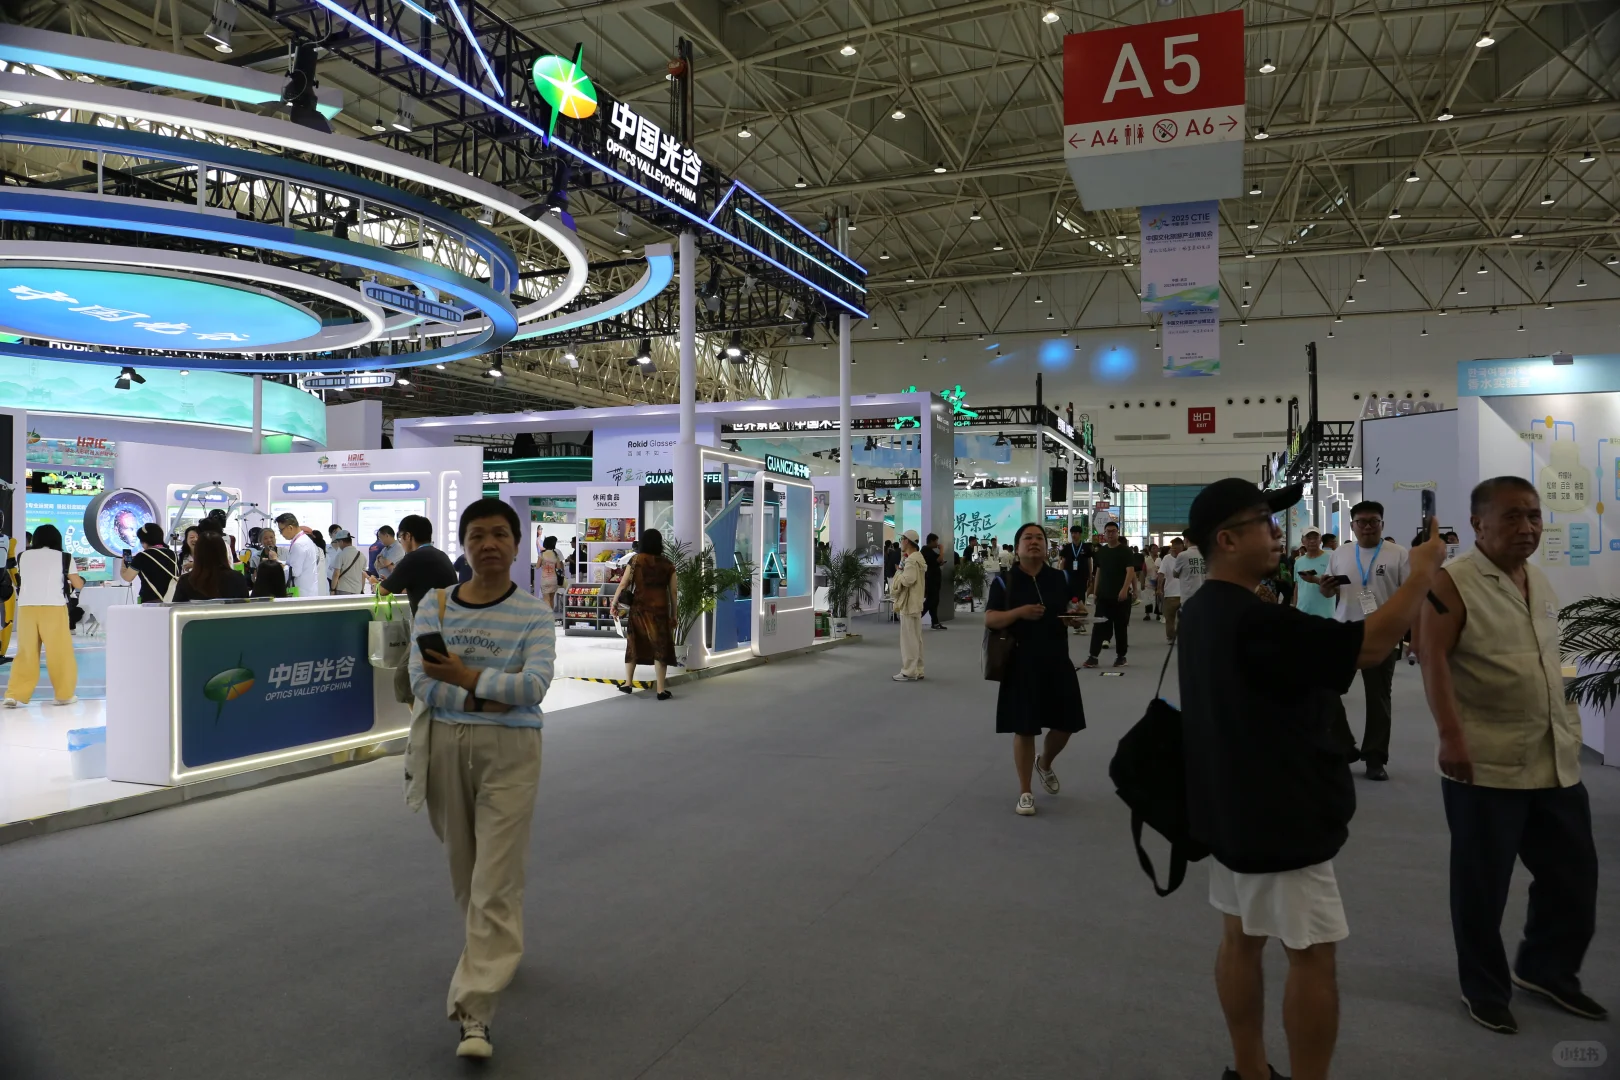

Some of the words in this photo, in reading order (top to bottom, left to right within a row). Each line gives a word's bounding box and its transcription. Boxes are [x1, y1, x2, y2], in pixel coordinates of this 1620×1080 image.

[1091, 127, 1119, 148] A4
[1185, 116, 1215, 139] A6
[611, 101, 702, 186] 中国光谷
[606, 138, 637, 166] OPTICS
[1171, 214, 1190, 222] 2025
[1190, 212, 1211, 221] CTIE
[1145, 230, 1214, 242] 中国文化旅游产业博览会
[1193, 412, 1212, 422] 出口
[627, 440, 648, 448] Rokid
[767, 455, 794, 475] GUANGZI
[593, 493, 620, 501] 休闲食品
[954, 511, 998, 536] 界景区
[267, 656, 356, 689] 中国光谷
[265, 689, 293, 701] OPTICS
